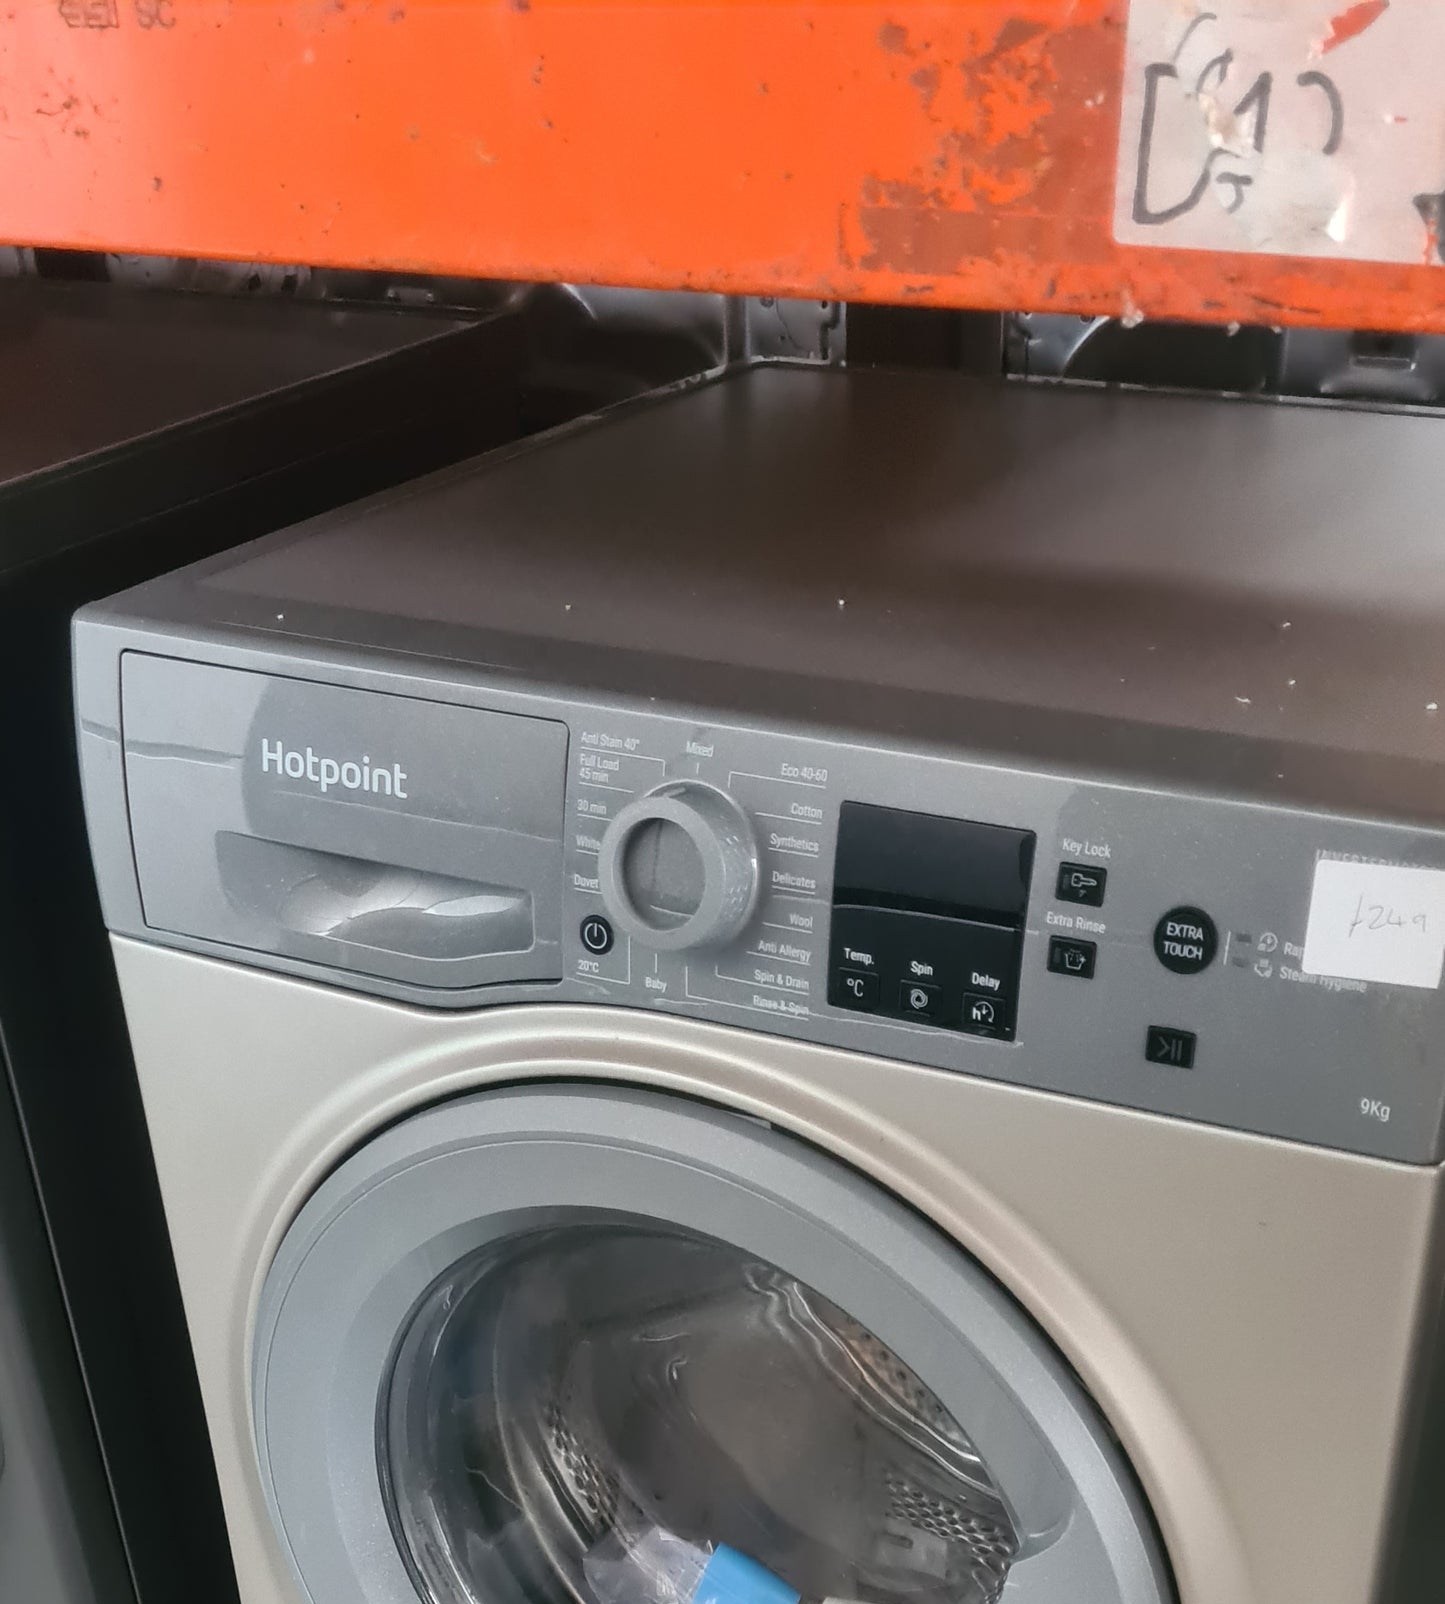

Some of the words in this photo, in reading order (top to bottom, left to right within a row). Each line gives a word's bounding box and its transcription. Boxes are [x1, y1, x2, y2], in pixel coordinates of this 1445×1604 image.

[581, 731, 599, 745] Anti
[686, 740, 715, 758] Mixed
[261, 737, 408, 799] Hotpoint
[580, 753, 597, 767] Full
[598, 757, 620, 771] Load
[579, 767, 591, 780] 45
[592, 770, 609, 784] min
[781, 762, 799, 778] Eco
[801, 766, 828, 782] 40-60
[577, 799, 589, 812] 30
[590, 803, 607, 815] min
[791, 803, 823, 819] Cotton
[770, 832, 819, 852] Synthetics
[1062, 837, 1083, 857] Key
[1084, 841, 1112, 859] Lock
[573, 873, 599, 889] Duvet
[772, 870, 816, 889] Delicates
[789, 912, 813, 928] Wool
[1046, 911, 1074, 928] Extra
[1075, 916, 1106, 934] Rinse
[1166, 921, 1204, 941] EXTRA
[758, 940, 777, 953] Anti
[779, 944, 812, 963] Allergy
[844, 947, 875, 966] Temp.
[1163, 941, 1204, 961] TOUCH
[577, 959, 600, 973] 20°C
[910, 960, 934, 977] Spin
[645, 976, 668, 993] Baby
[754, 969, 775, 984] Spin
[776, 973, 784, 985] &
[785, 975, 810, 990] Drain
[846, 977, 865, 997] °C
[971, 971, 1001, 992] Delay
[753, 994, 778, 1010] Rinse
[779, 1000, 787, 1011] &
[788, 1001, 810, 1016] Spin
[1360, 1097, 1391, 1122] 9Kg
